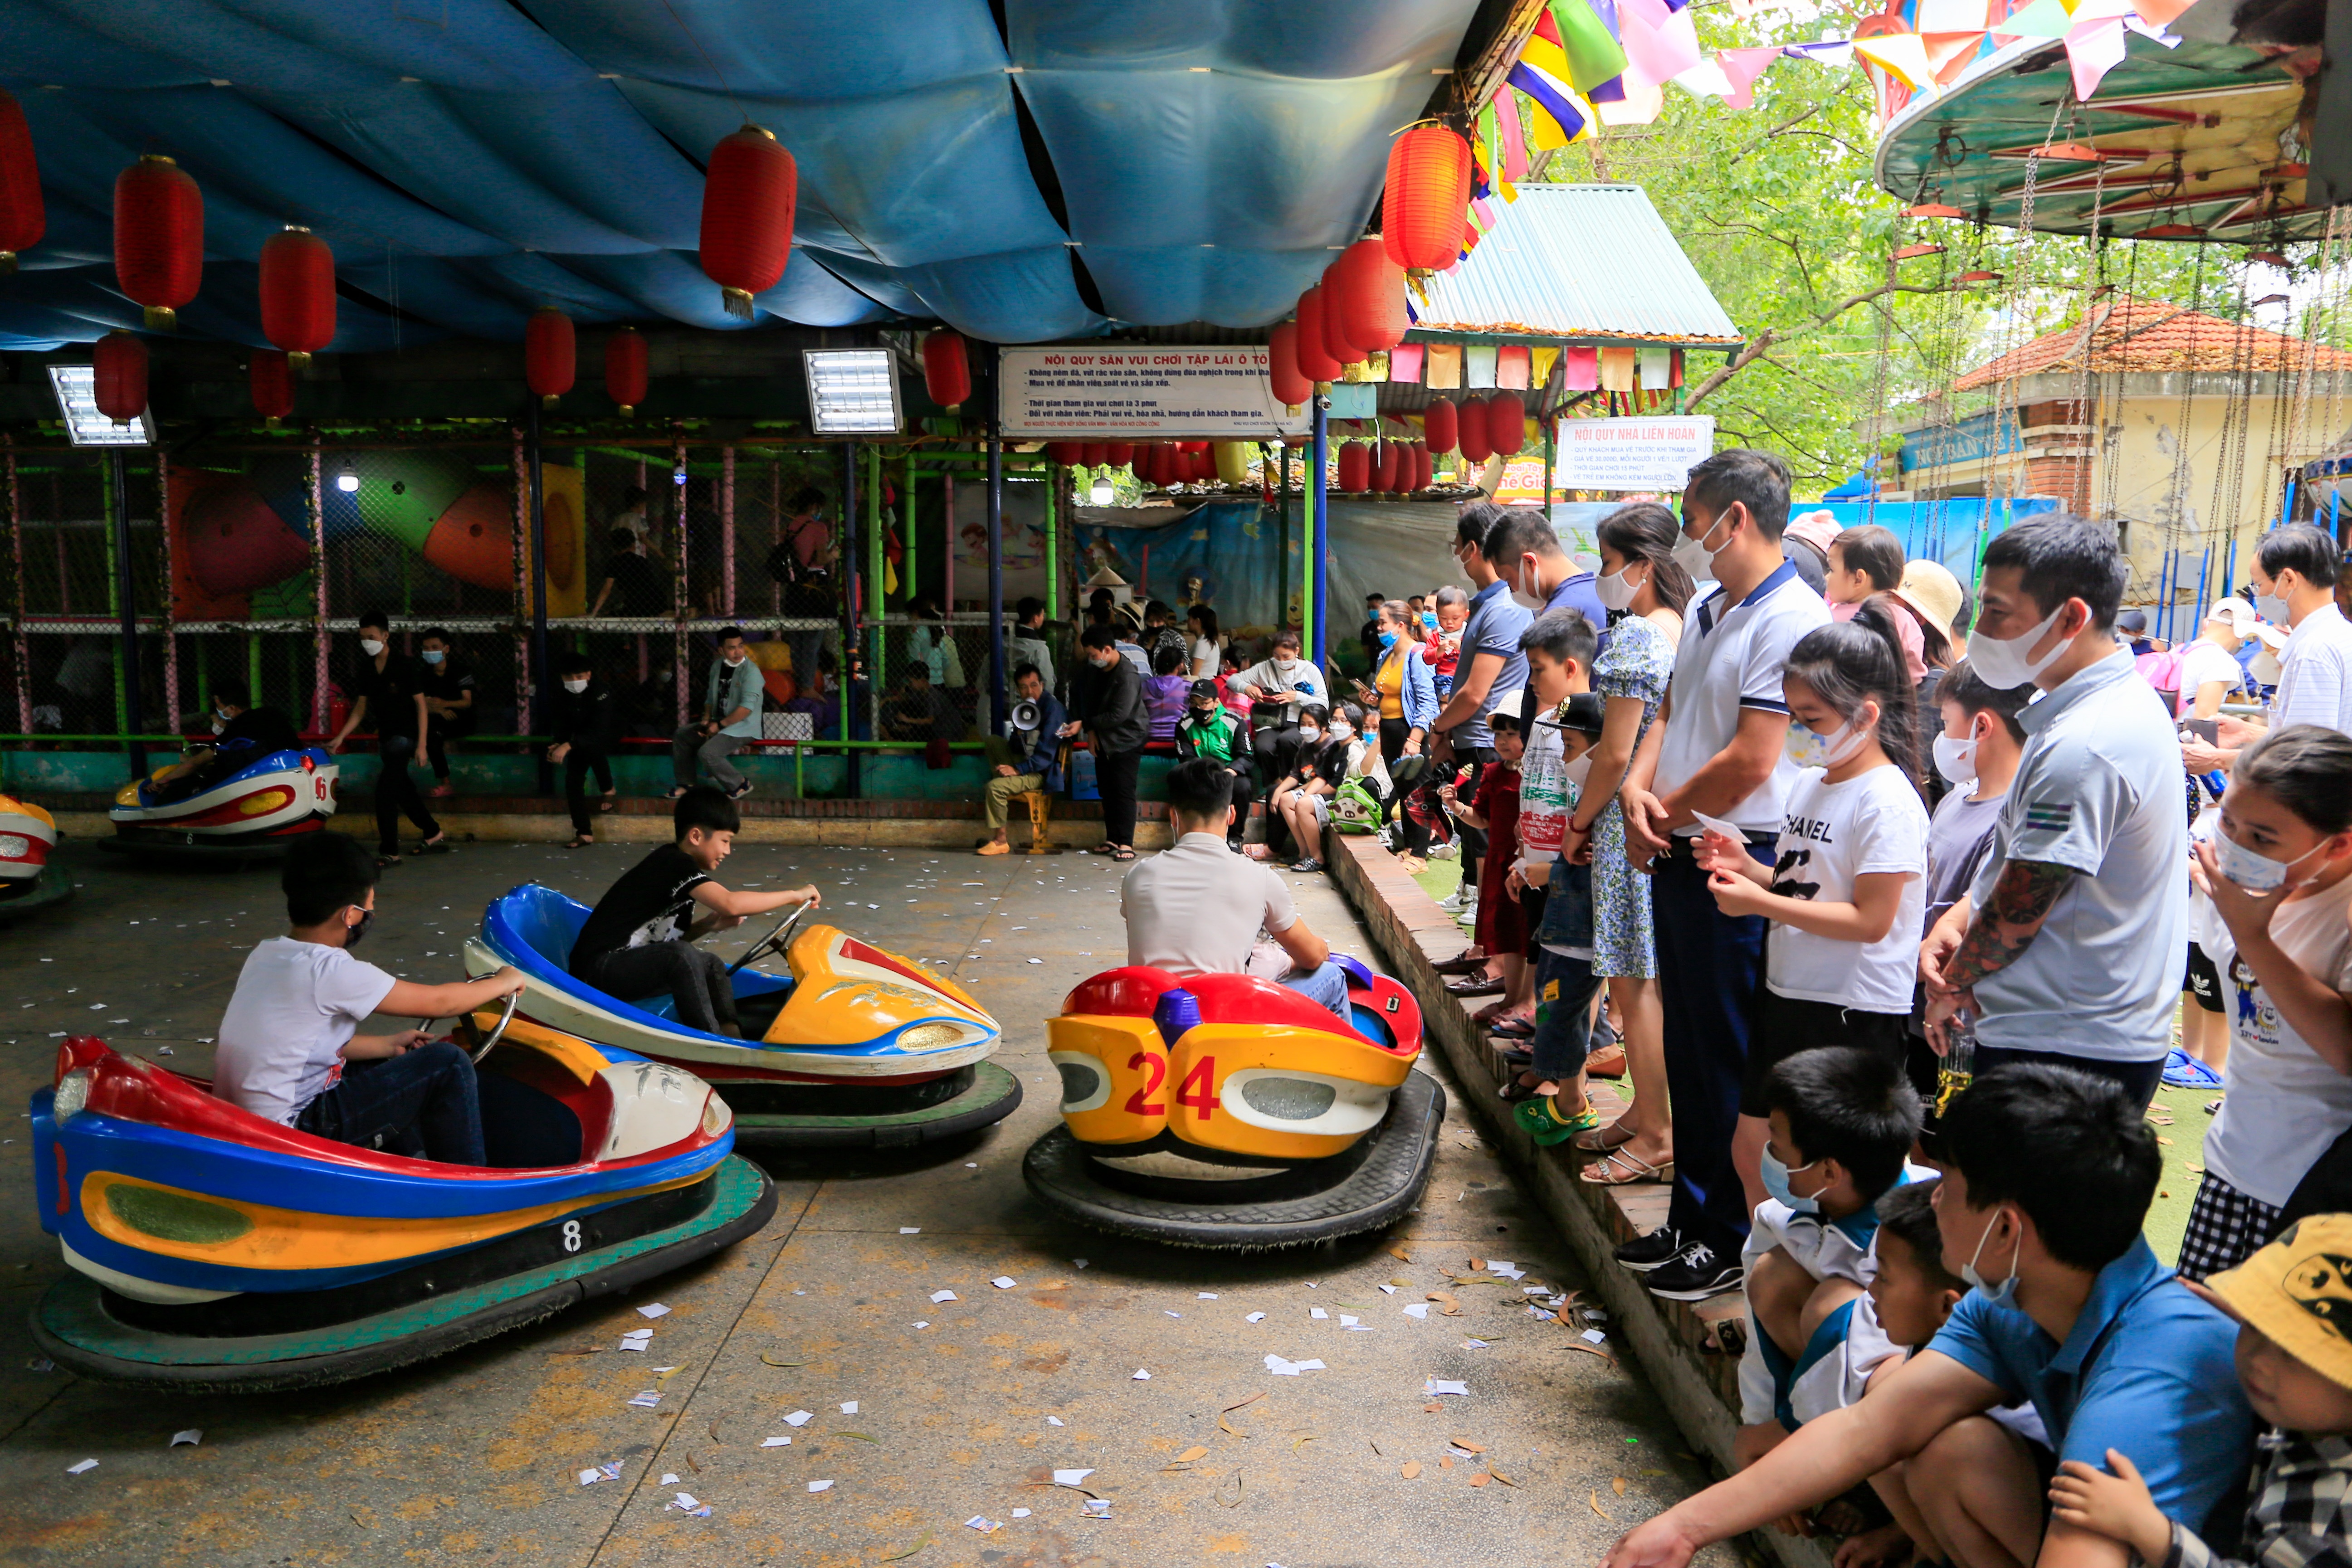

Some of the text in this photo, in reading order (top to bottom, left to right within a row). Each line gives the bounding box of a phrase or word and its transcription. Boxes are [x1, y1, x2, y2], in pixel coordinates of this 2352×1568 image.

[1045, 354, 1268, 367] NỘI QUY SÂN VUI CHƠI TẬP LÁI Ô TÔ
[1199, 369, 1223, 377] nghịch
[1575, 425, 1696, 443] NỘI QUY NHÀ LIÊN HOÀN
[315, 776, 327, 802] 6
[186, 833, 194, 845] 6
[1782, 814, 1832, 844] CHANEL
[1124, 1051, 1220, 1121] 24
[563, 1219, 582, 1252] 8
